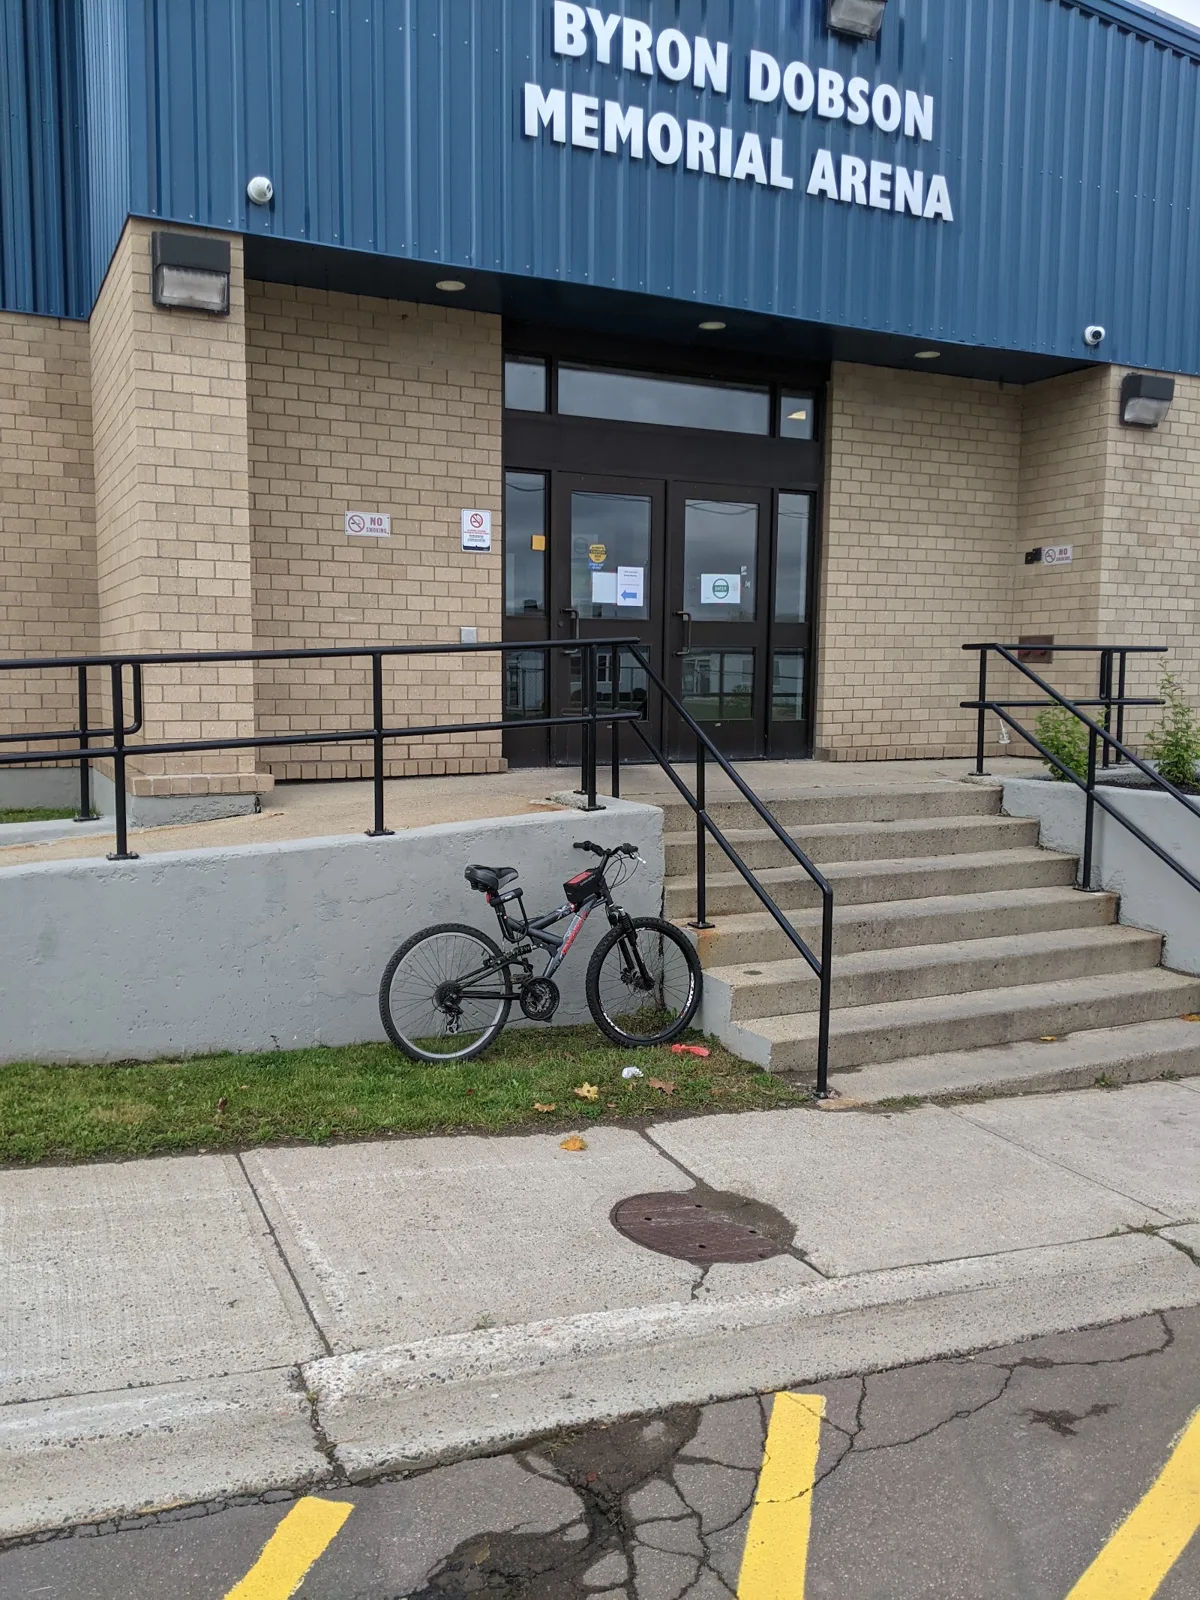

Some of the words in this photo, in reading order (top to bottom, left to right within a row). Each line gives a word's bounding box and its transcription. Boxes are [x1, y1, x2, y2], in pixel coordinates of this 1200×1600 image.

[553, 0, 728, 94] BYRON
[749, 49, 934, 142] DOBSON
[524, 82, 794, 190] MEMORIAL
[806, 149, 954, 222] ARENA
[370, 516, 383, 527] NO
